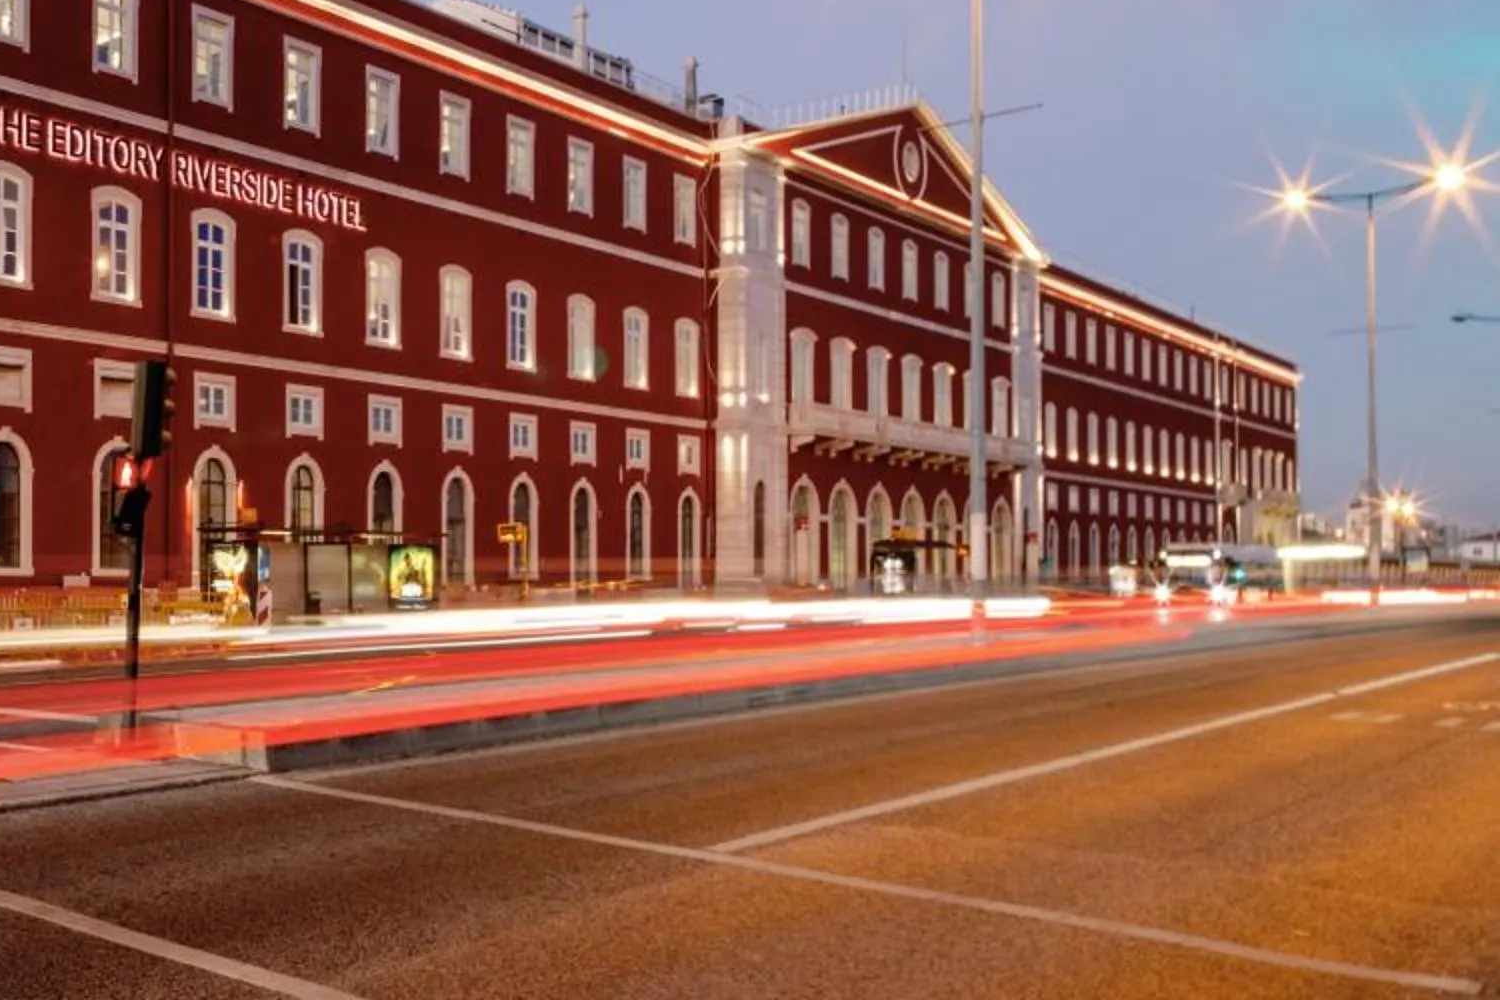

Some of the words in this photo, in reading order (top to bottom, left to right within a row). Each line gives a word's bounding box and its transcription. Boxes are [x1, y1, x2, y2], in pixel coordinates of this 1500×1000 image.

[47, 118, 163, 181] EDITORY
[171, 152, 293, 213] RIVERSIDE
[297, 184, 368, 232] HOTEL
